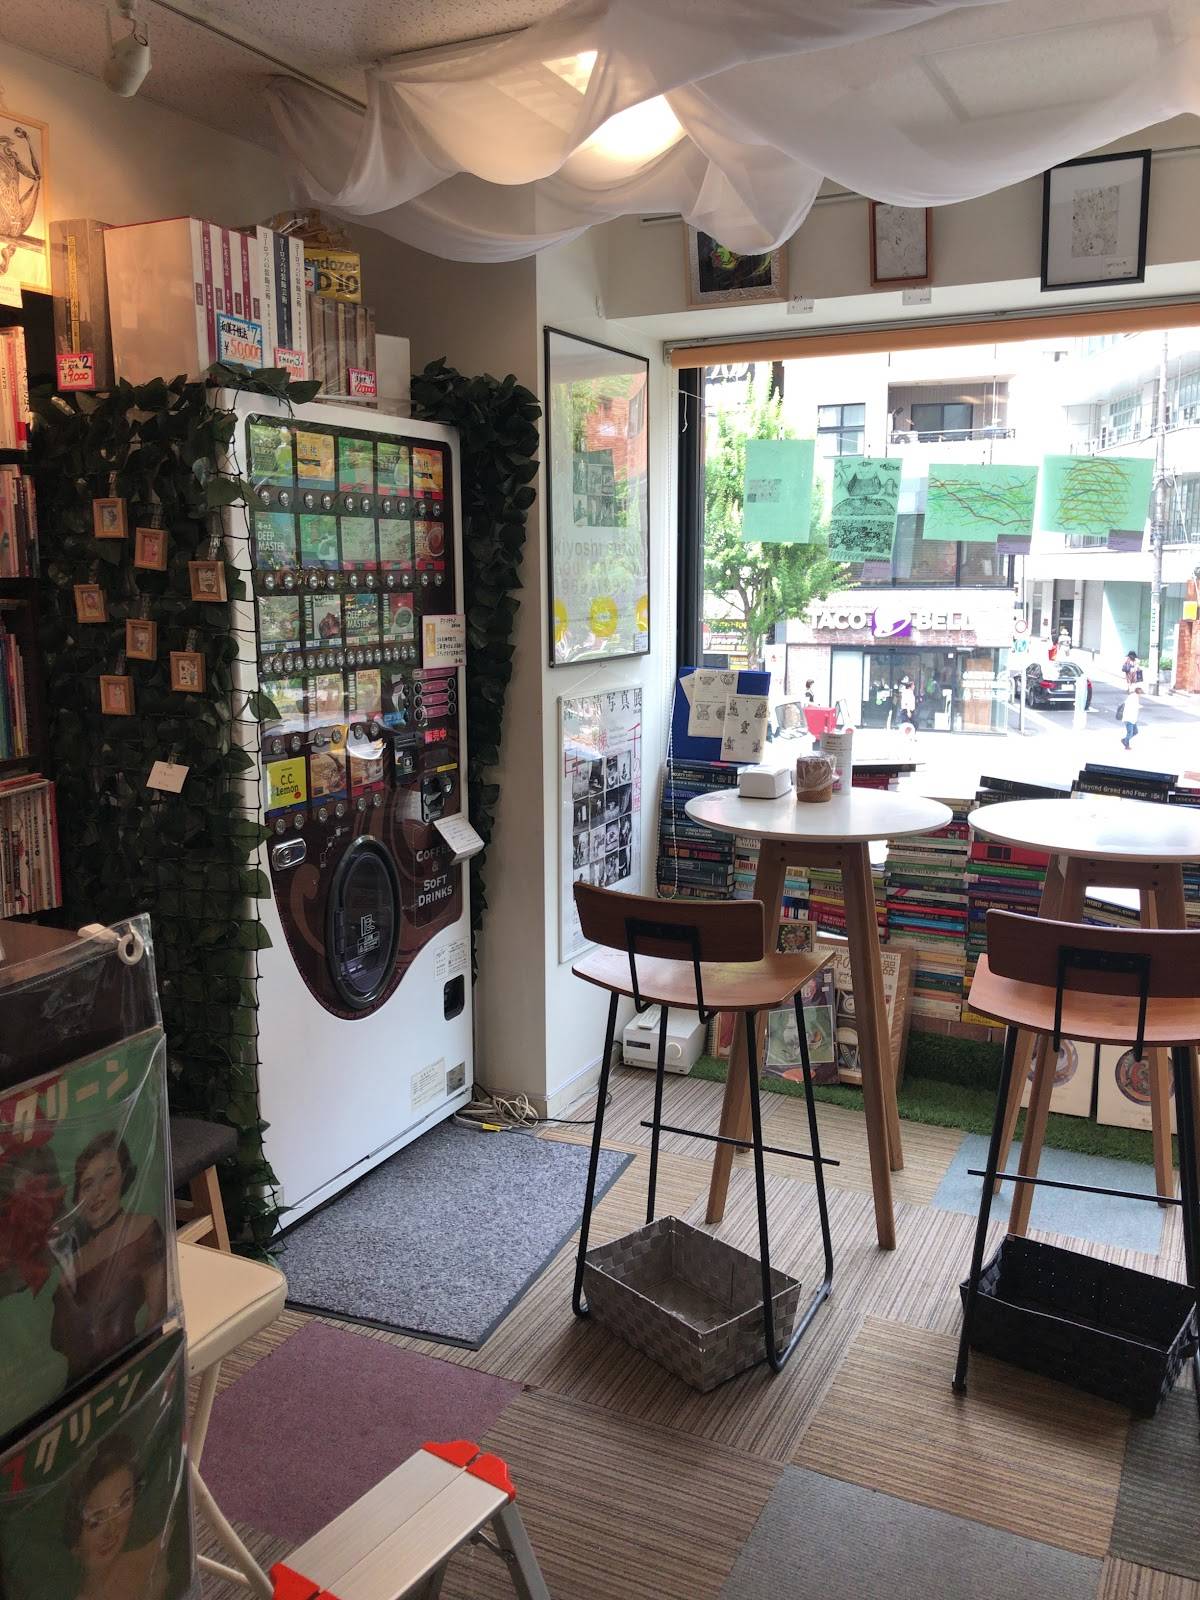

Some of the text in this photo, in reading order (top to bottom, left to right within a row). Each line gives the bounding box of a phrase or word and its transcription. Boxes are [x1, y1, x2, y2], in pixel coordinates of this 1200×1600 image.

[257, 530, 275, 541] DEEP
[258, 541, 285, 552] MASTER
[808, 609, 974, 631] TACO BELL
[1080, 782, 1148, 798] Beyond Greed and Fear
[423, 873, 448, 892] SOFT
[418, 885, 453, 907] DRINKS
[8, 1059, 129, 1144] クリーン
